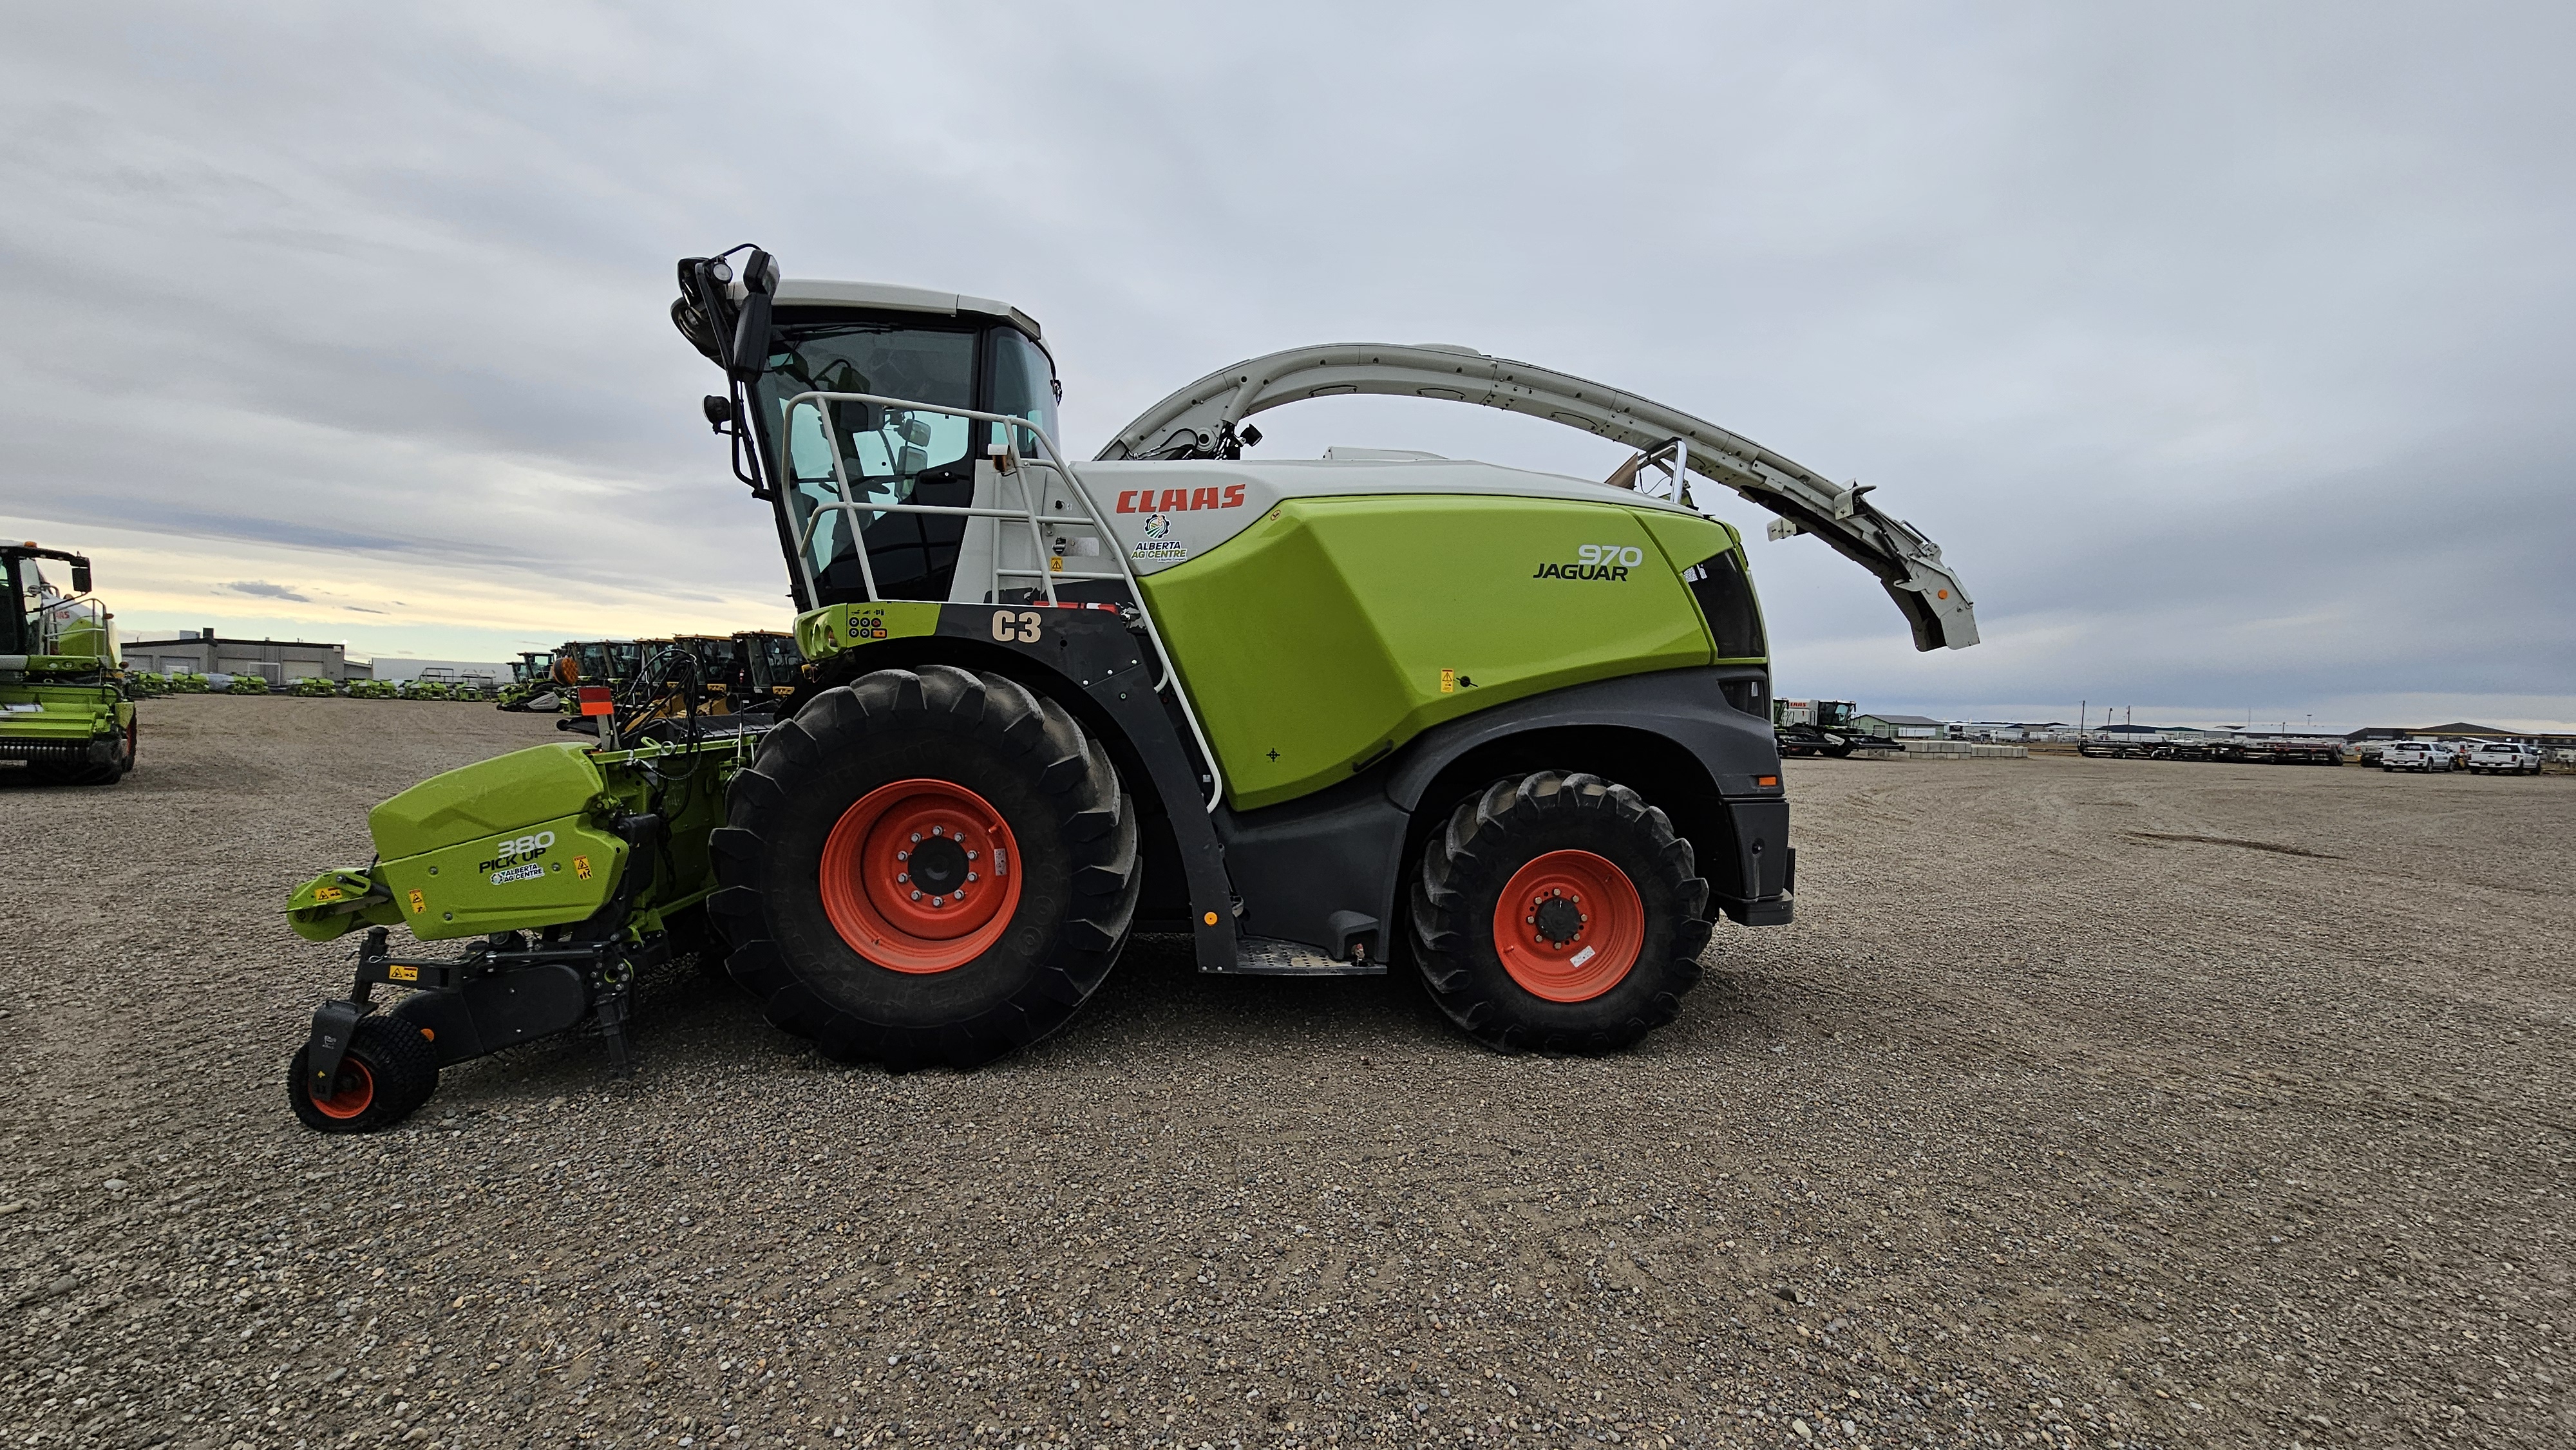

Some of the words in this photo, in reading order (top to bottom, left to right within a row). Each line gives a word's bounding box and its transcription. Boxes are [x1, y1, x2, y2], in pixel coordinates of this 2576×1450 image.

[1116, 484, 1245, 513] CLAAS
[1131, 551, 1145, 559] AG
[1148, 550, 1186, 558] CENTRE
[1135, 541, 1180, 551] ALBERTA
[1578, 544, 1643, 567] 970
[1533, 563, 1628, 581] JAGUAR
[992, 610, 1041, 643] C3
[498, 831, 555, 858] 380
[479, 854, 517, 873] PICK
[522, 847, 546, 862] UP
[506, 863, 538, 876] ALBERTA
[516, 868, 542, 880] CENTRE
